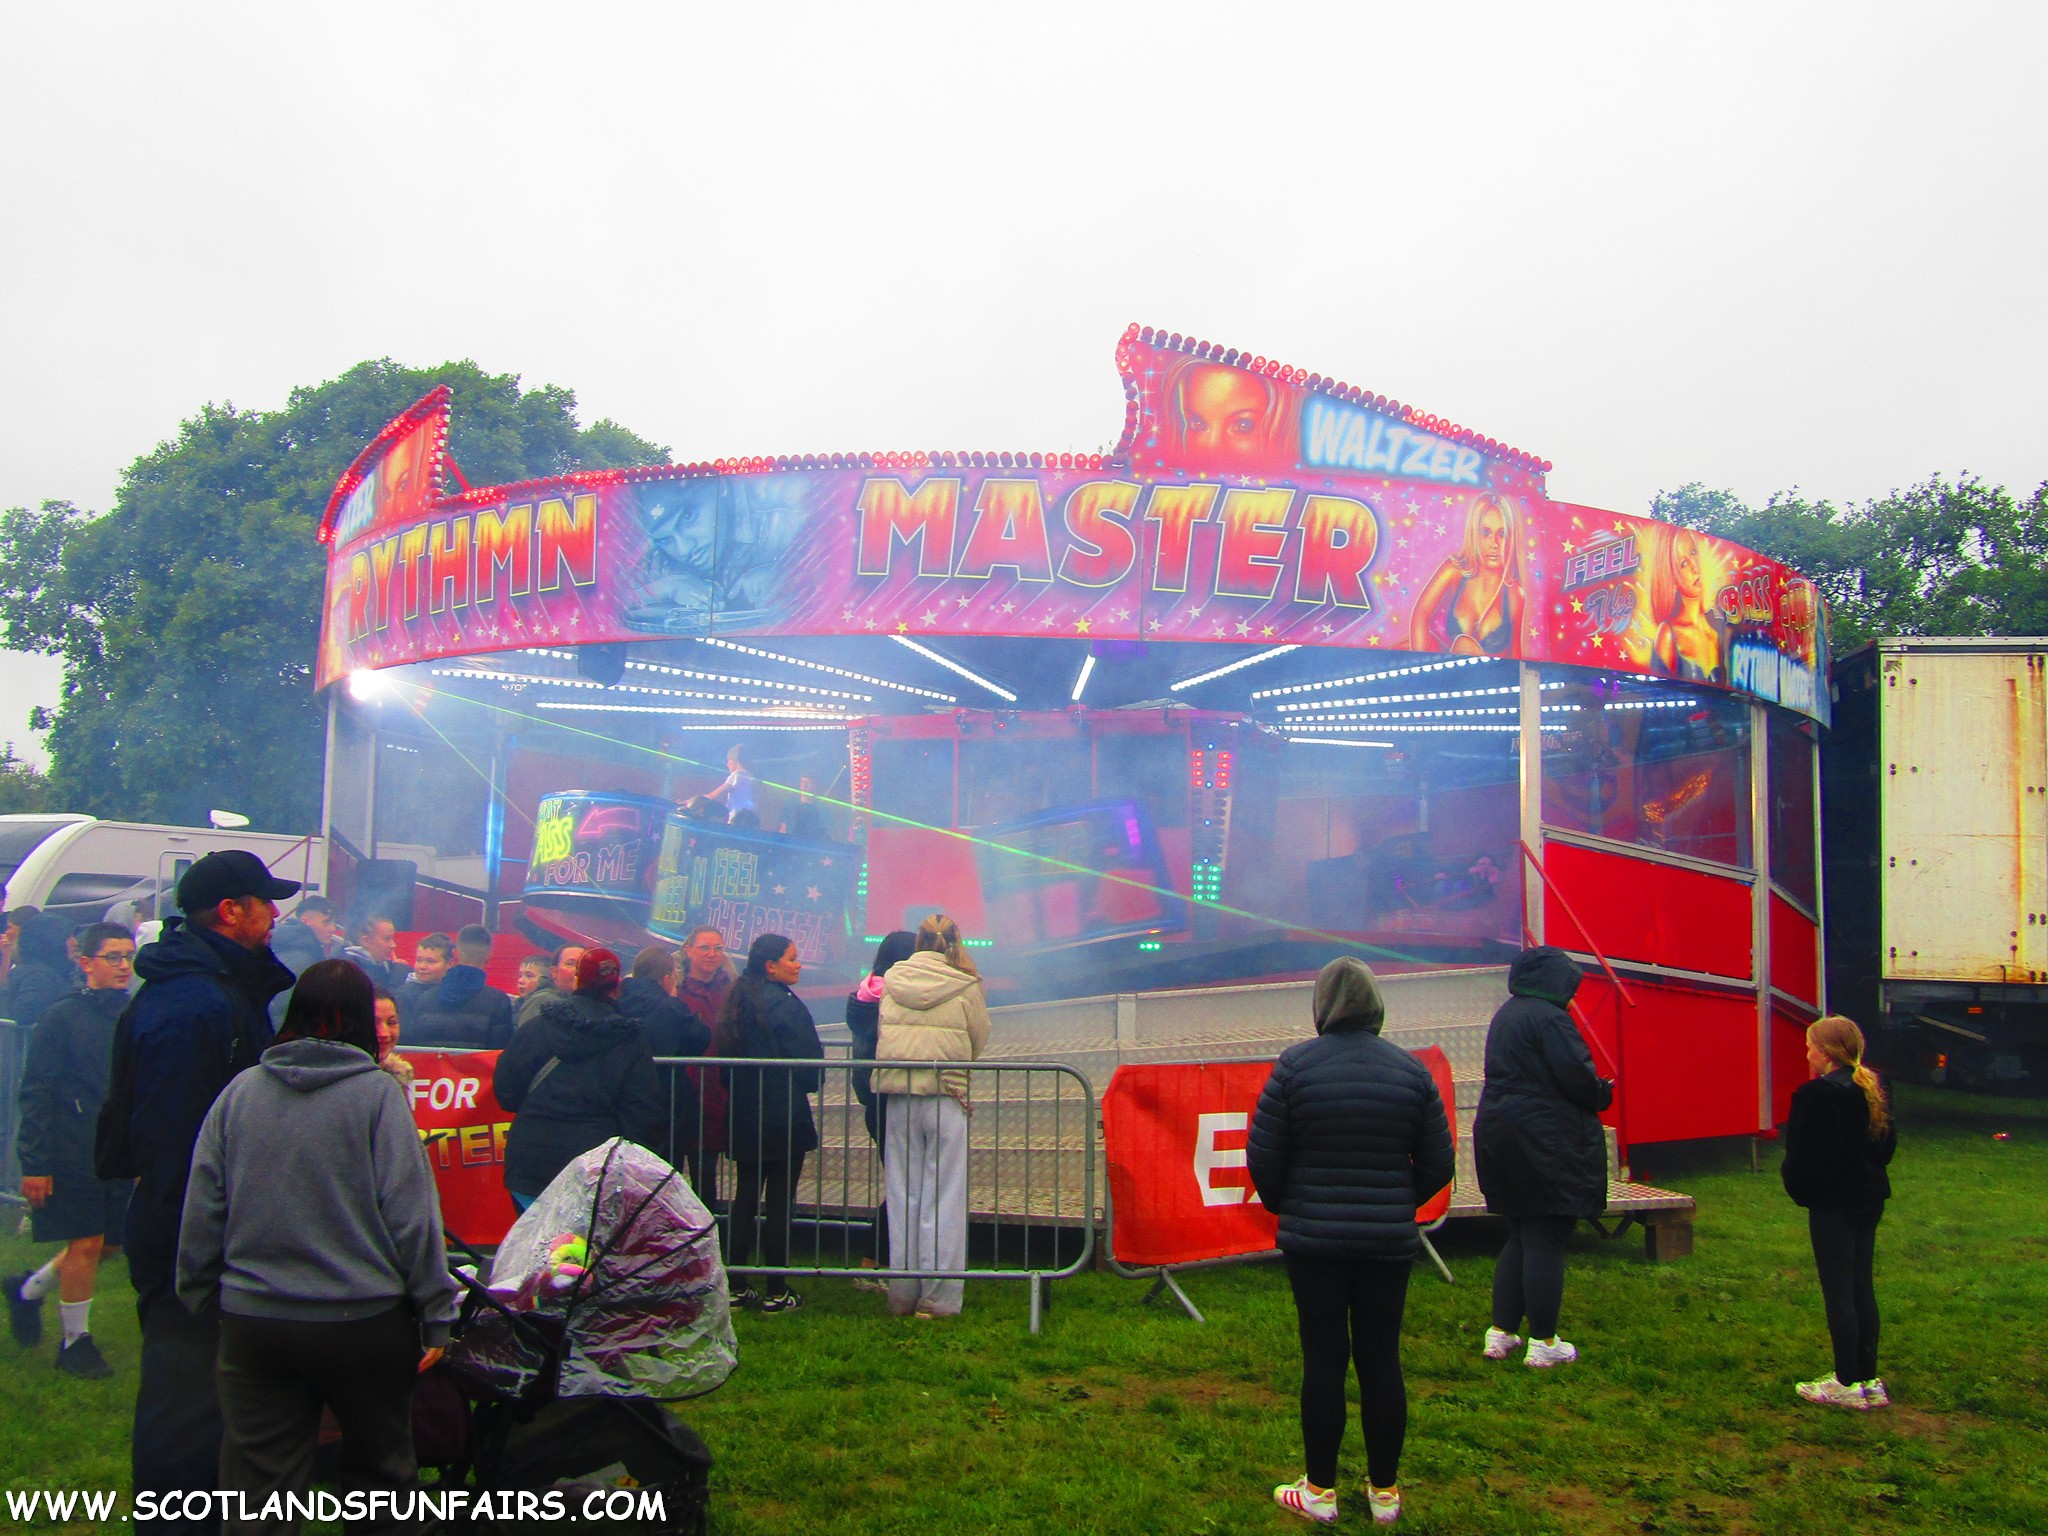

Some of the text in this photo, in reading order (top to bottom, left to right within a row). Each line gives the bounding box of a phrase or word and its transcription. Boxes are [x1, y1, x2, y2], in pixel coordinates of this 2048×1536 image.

[1307, 403, 1482, 484] WALTZER
[348, 492, 598, 645] RYTHMN
[857, 478, 1378, 610] MASTER
[1564, 536, 1640, 588] FEEL
[1718, 574, 1774, 625] BASS
[532, 816, 574, 867] ASS
[544, 851, 591, 886] FOR
[597, 840, 640, 882] ME
[712, 847, 761, 897] FEEL
[706, 896, 750, 950] THE
[407, 1077, 480, 1111] FOR
